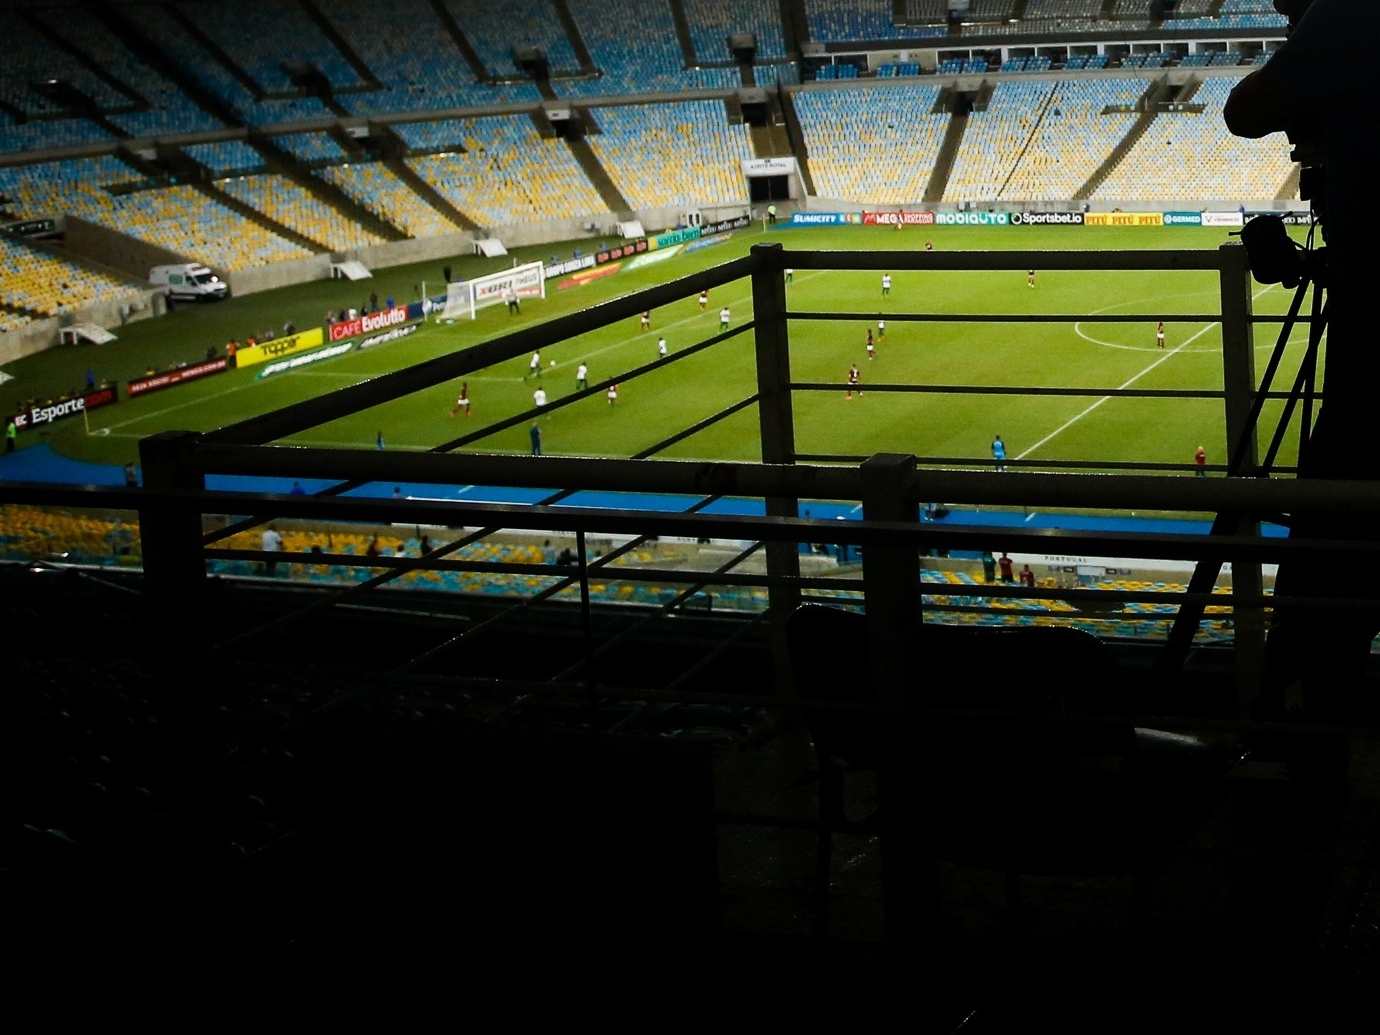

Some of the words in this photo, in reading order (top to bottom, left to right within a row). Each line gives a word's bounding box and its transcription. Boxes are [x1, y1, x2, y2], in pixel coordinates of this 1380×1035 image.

[793, 214, 836, 223] SUMICITY
[1022, 213, 1083, 225] Sportsbet.io
[1172, 215, 1200, 223] GERMED
